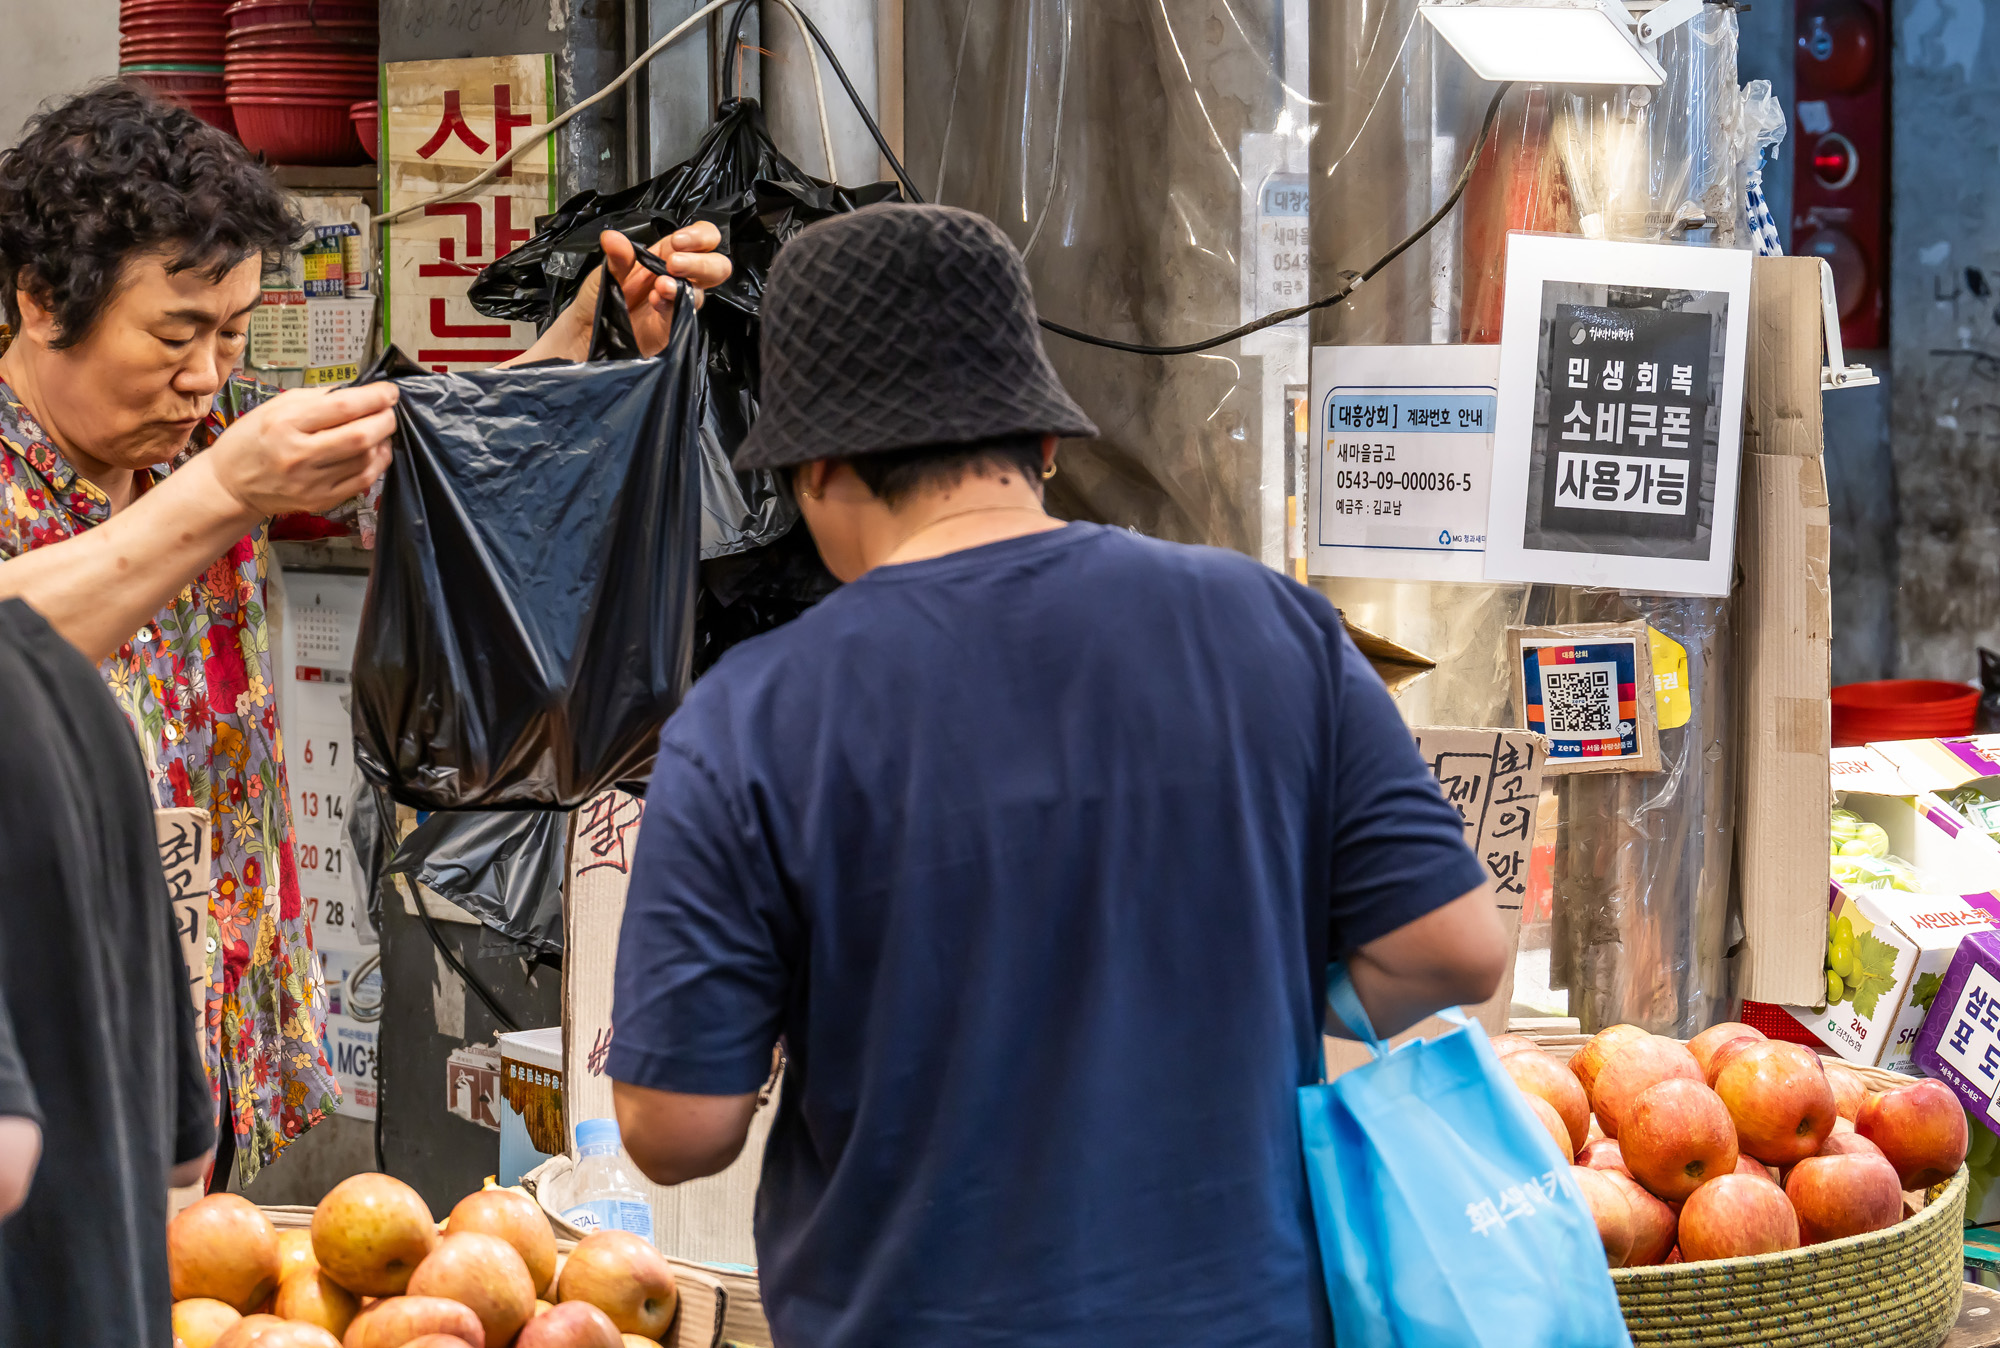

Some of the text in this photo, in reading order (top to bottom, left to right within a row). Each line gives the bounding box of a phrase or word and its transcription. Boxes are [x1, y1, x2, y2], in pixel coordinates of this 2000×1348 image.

[1407, 408, 1451, 428] 계좌번호
[1458, 409, 1483, 428] 안내
[1561, 400, 1691, 449] 소비쿠폰
[1337, 443, 1396, 463] 새마을금고
[1559, 459, 1685, 507] 사용가능
[1335, 499, 1364, 515] 예금주
[1373, 500, 1403, 516] 김교남
[1452, 534, 1463, 543] MG
[304, 739, 339, 766] 6 7
[1557, 743, 1581, 753] zero
[301, 791, 343, 820] 13 14
[300, 843, 342, 873] 20 21
[306, 896, 344, 926] 7 28
[1850, 1018, 1868, 1040] 2kg
